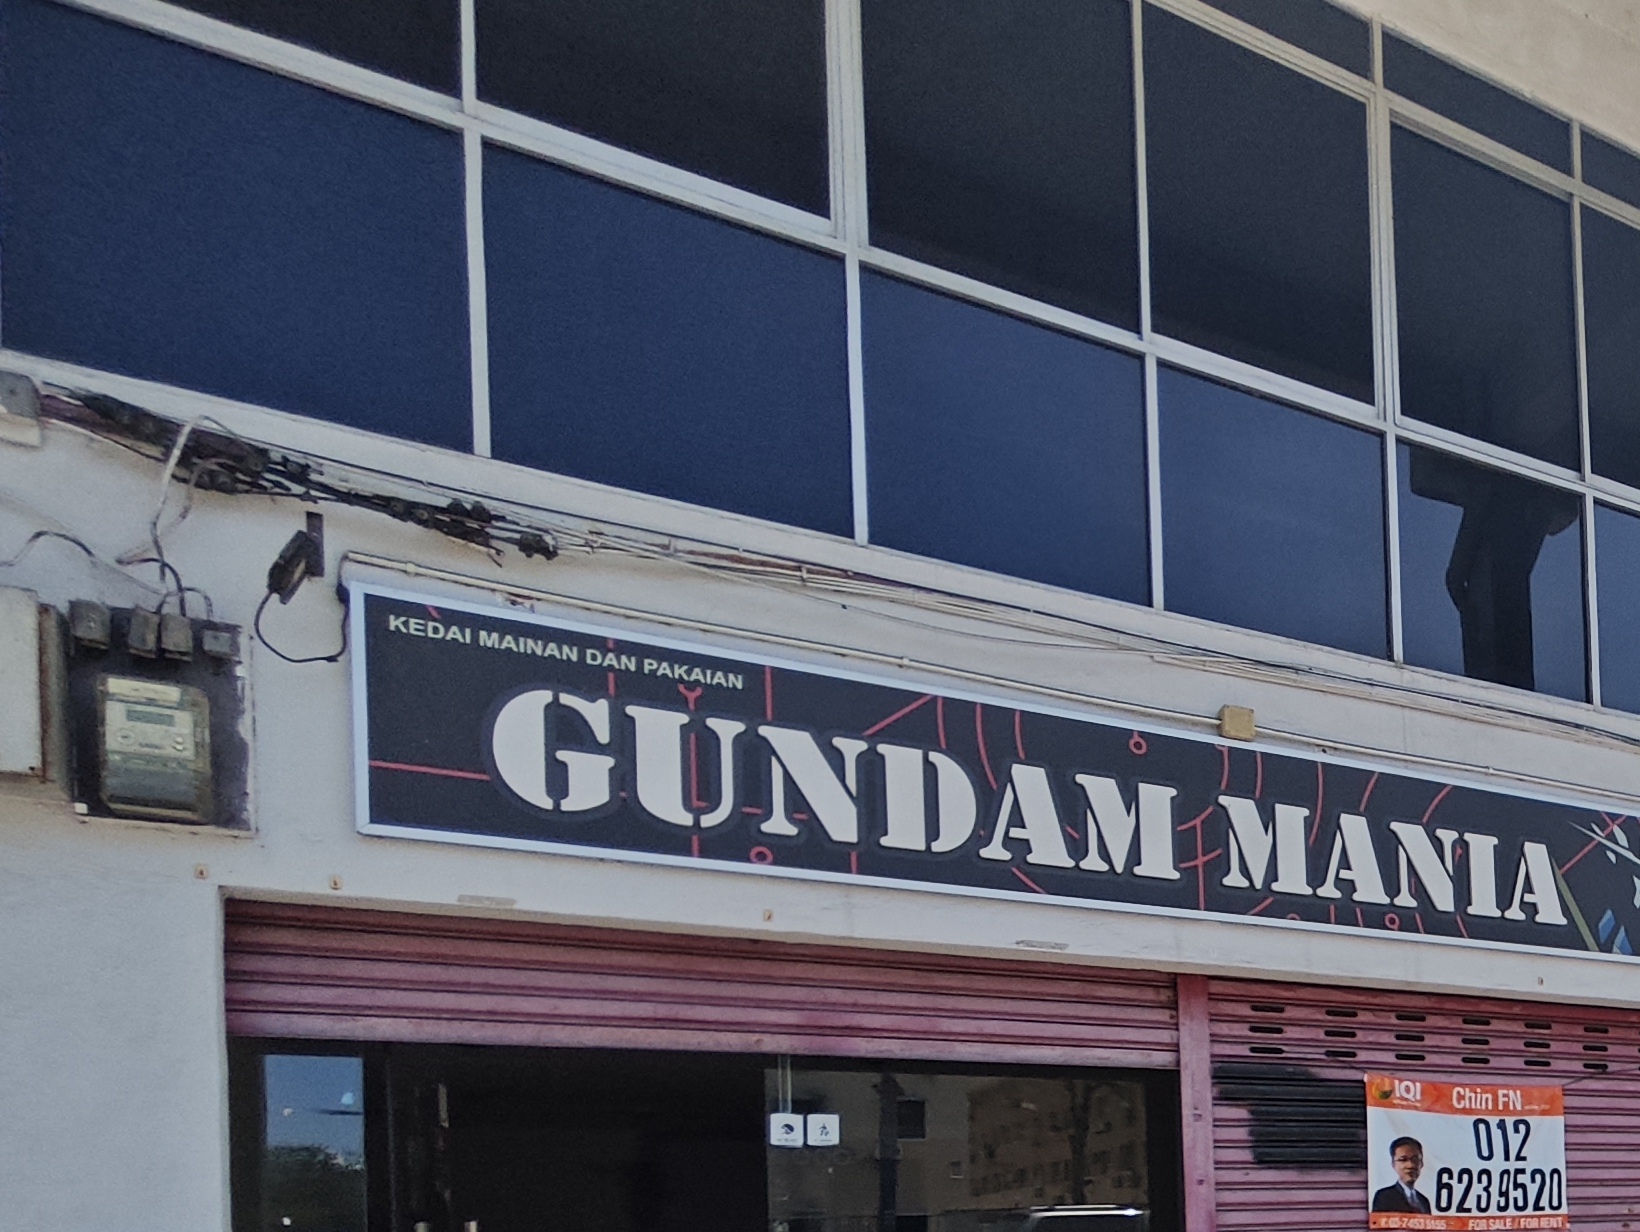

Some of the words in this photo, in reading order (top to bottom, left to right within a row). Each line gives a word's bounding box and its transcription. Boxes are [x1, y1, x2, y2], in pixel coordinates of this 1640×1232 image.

[388, 614, 471, 644] KEDAI
[478, 630, 578, 662] MAINAN
[586, 648, 637, 672] DAN
[643, 659, 744, 690] PAKAIAN
[491, 688, 1181, 881] GUNDAM
[1217, 795, 1568, 926] MANIA
[1394, 1080, 1422, 1102] IQI
[1452, 1087, 1492, 1110] Chin
[1498, 1089, 1523, 1111] FN
[1473, 1118, 1531, 1162] 012
[1435, 1167, 1563, 1214] 6239520
[1468, 1219, 1488, 1230] FOR
[1489, 1219, 1513, 1230] SALE
[1520, 1217, 1539, 1229] FOR
[1540, 1217, 1563, 1228] RENT
